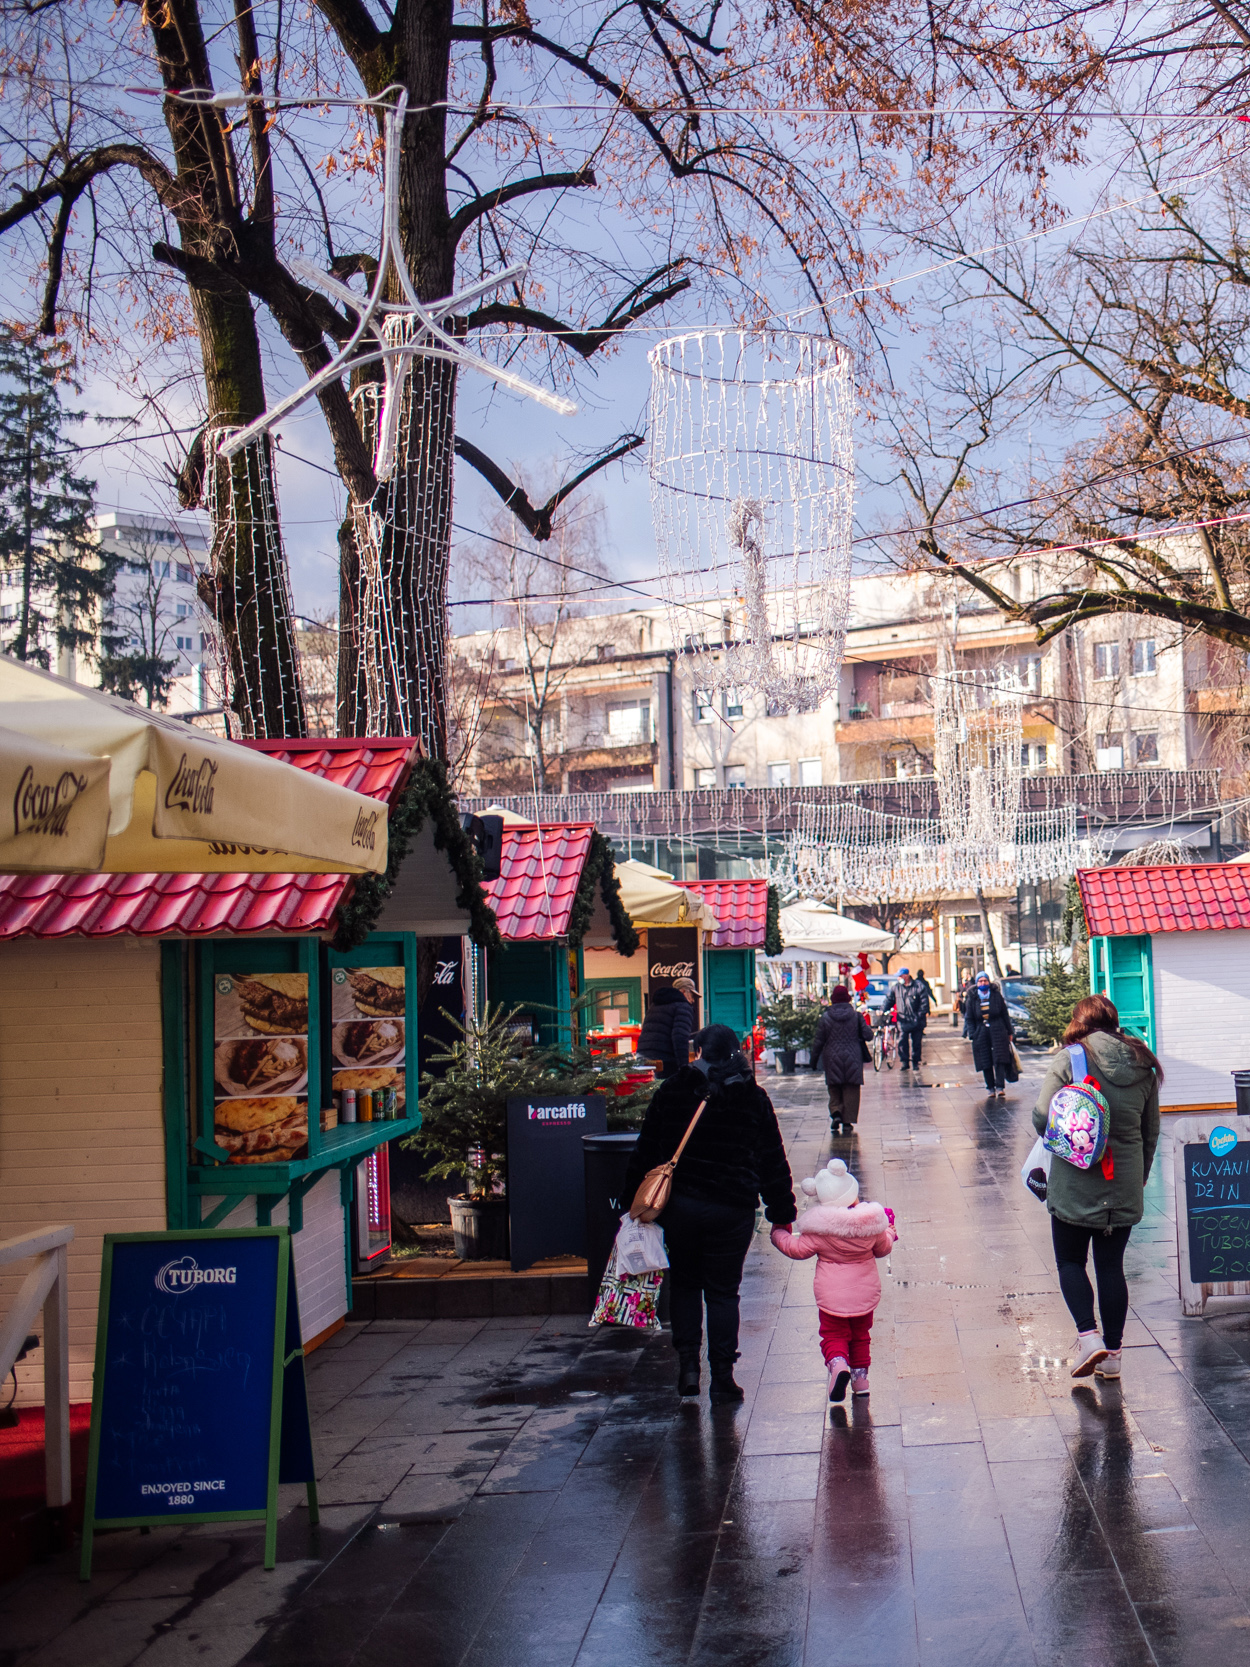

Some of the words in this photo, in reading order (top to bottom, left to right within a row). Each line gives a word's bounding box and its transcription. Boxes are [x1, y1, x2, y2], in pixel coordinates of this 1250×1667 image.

[650, 961, 695, 978] Coca-Cola
[527, 1102, 587, 1120] barcaffé
[1191, 1159, 1250, 1178] KUVANI
[1194, 1180, 1240, 1200] DŽIN
[168, 1266, 237, 1287] TUBORG
[141, 1482, 191, 1495] ENJOYED
[193, 1480, 226, 1492] SINCE
[168, 1494, 195, 1506] 1880
